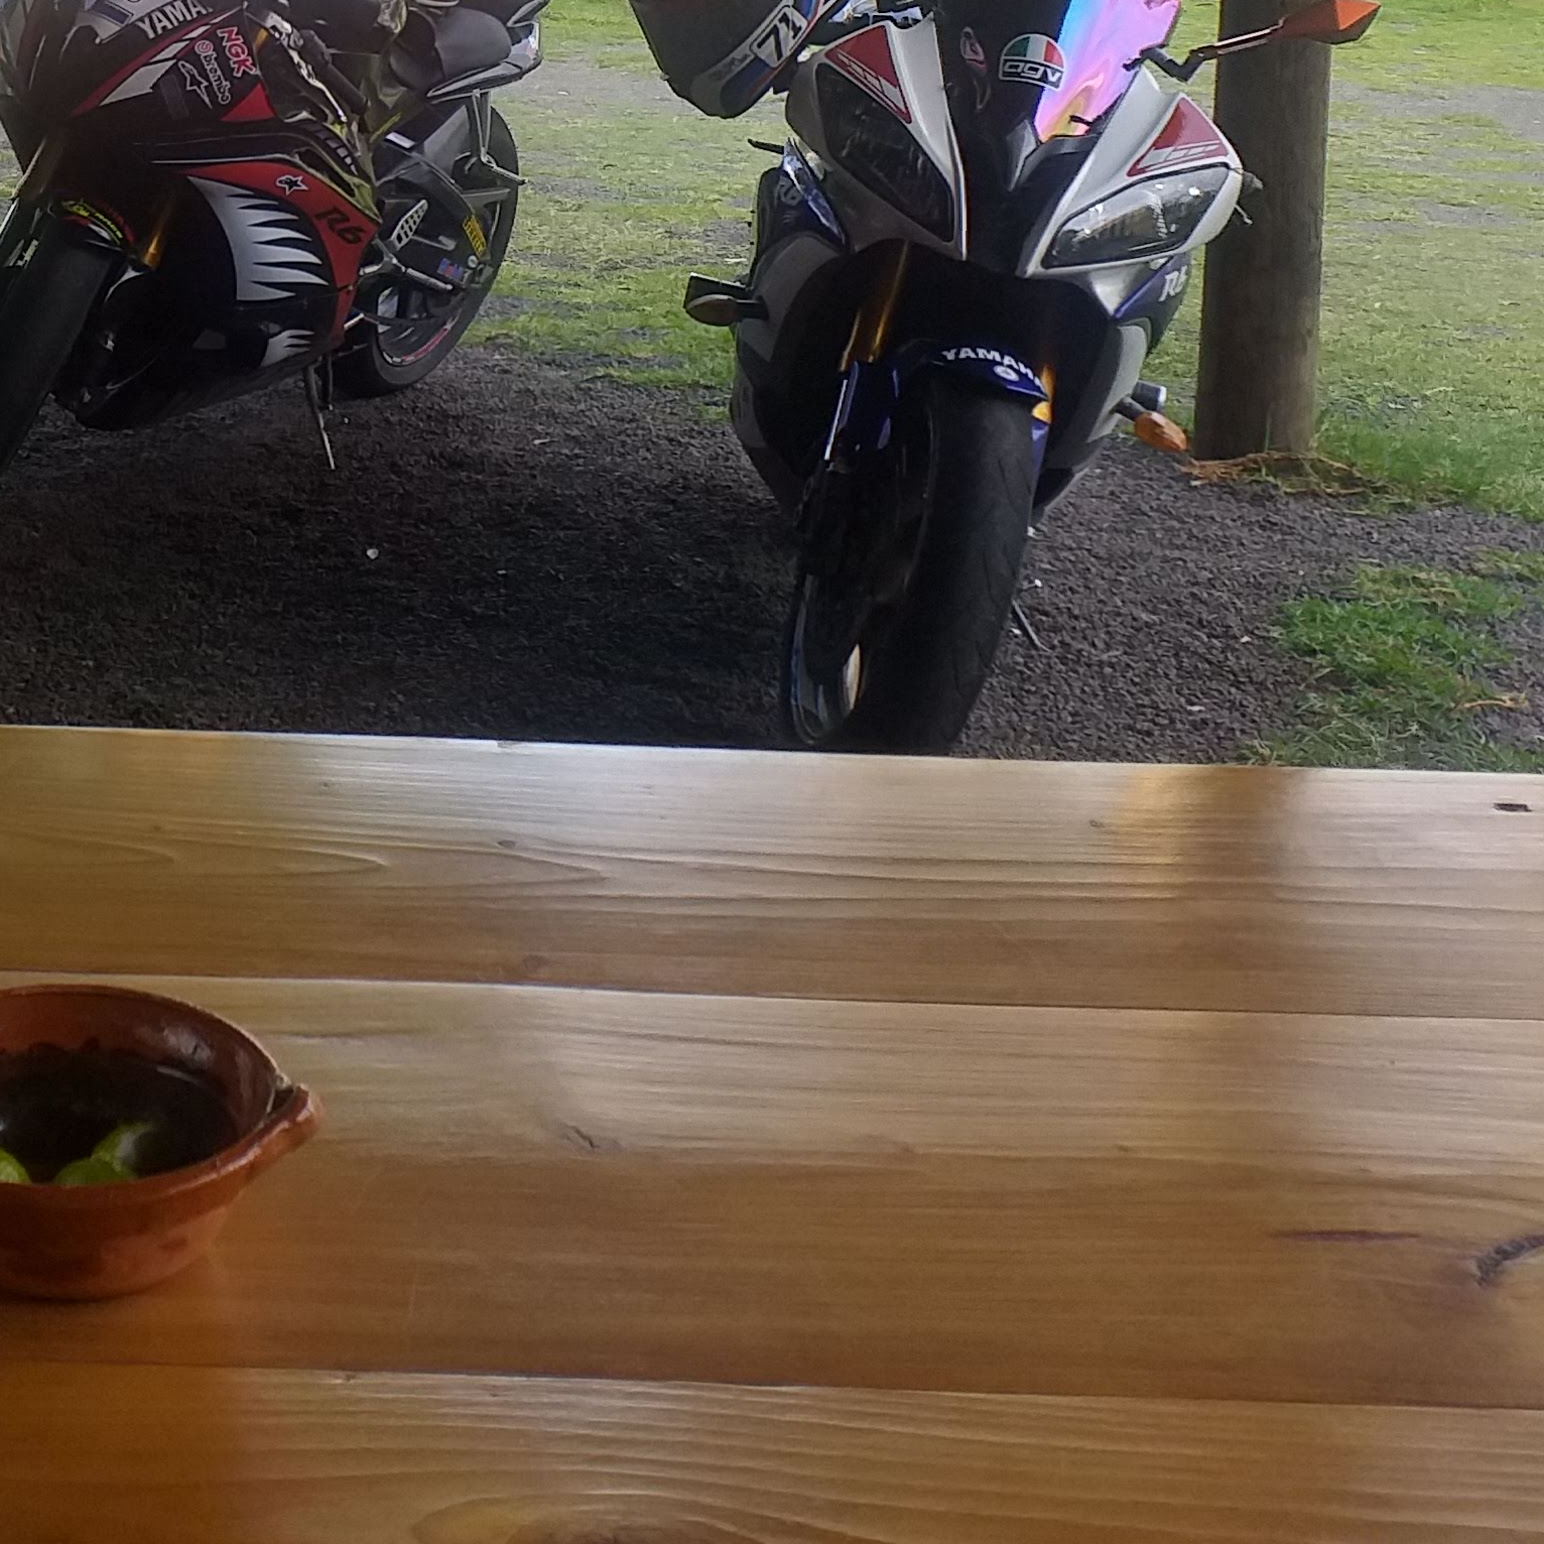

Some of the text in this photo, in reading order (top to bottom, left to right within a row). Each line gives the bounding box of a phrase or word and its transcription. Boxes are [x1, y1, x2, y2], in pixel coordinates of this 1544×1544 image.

[217, 26, 256, 77] NGK
[756, 11, 802, 62] 71
[200, 51, 231, 104] brembo
[1002, 60, 1062, 83] agv
[312, 207, 366, 245] R6
